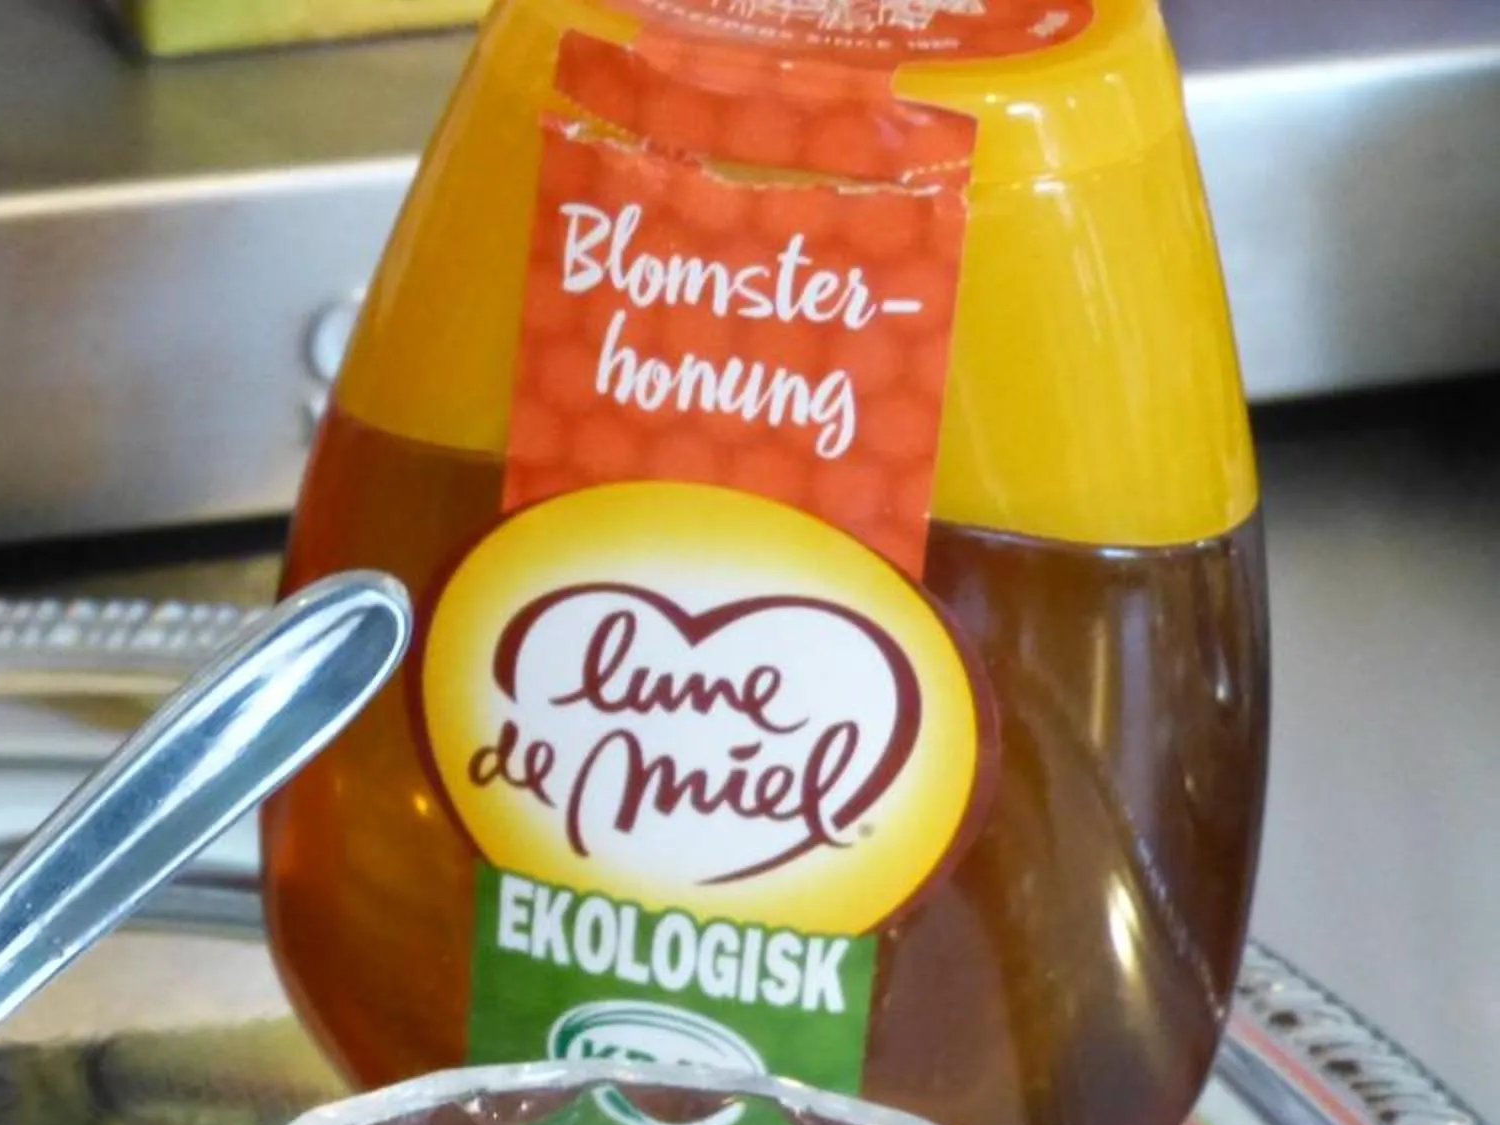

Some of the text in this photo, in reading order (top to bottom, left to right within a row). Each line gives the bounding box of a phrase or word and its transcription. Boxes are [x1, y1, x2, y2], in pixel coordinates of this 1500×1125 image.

[560, 203, 923, 330] Blomster-
[596, 311, 857, 460] honung
[469, 721, 556, 808] de
[497, 875, 849, 1012] EKOLOGISK
